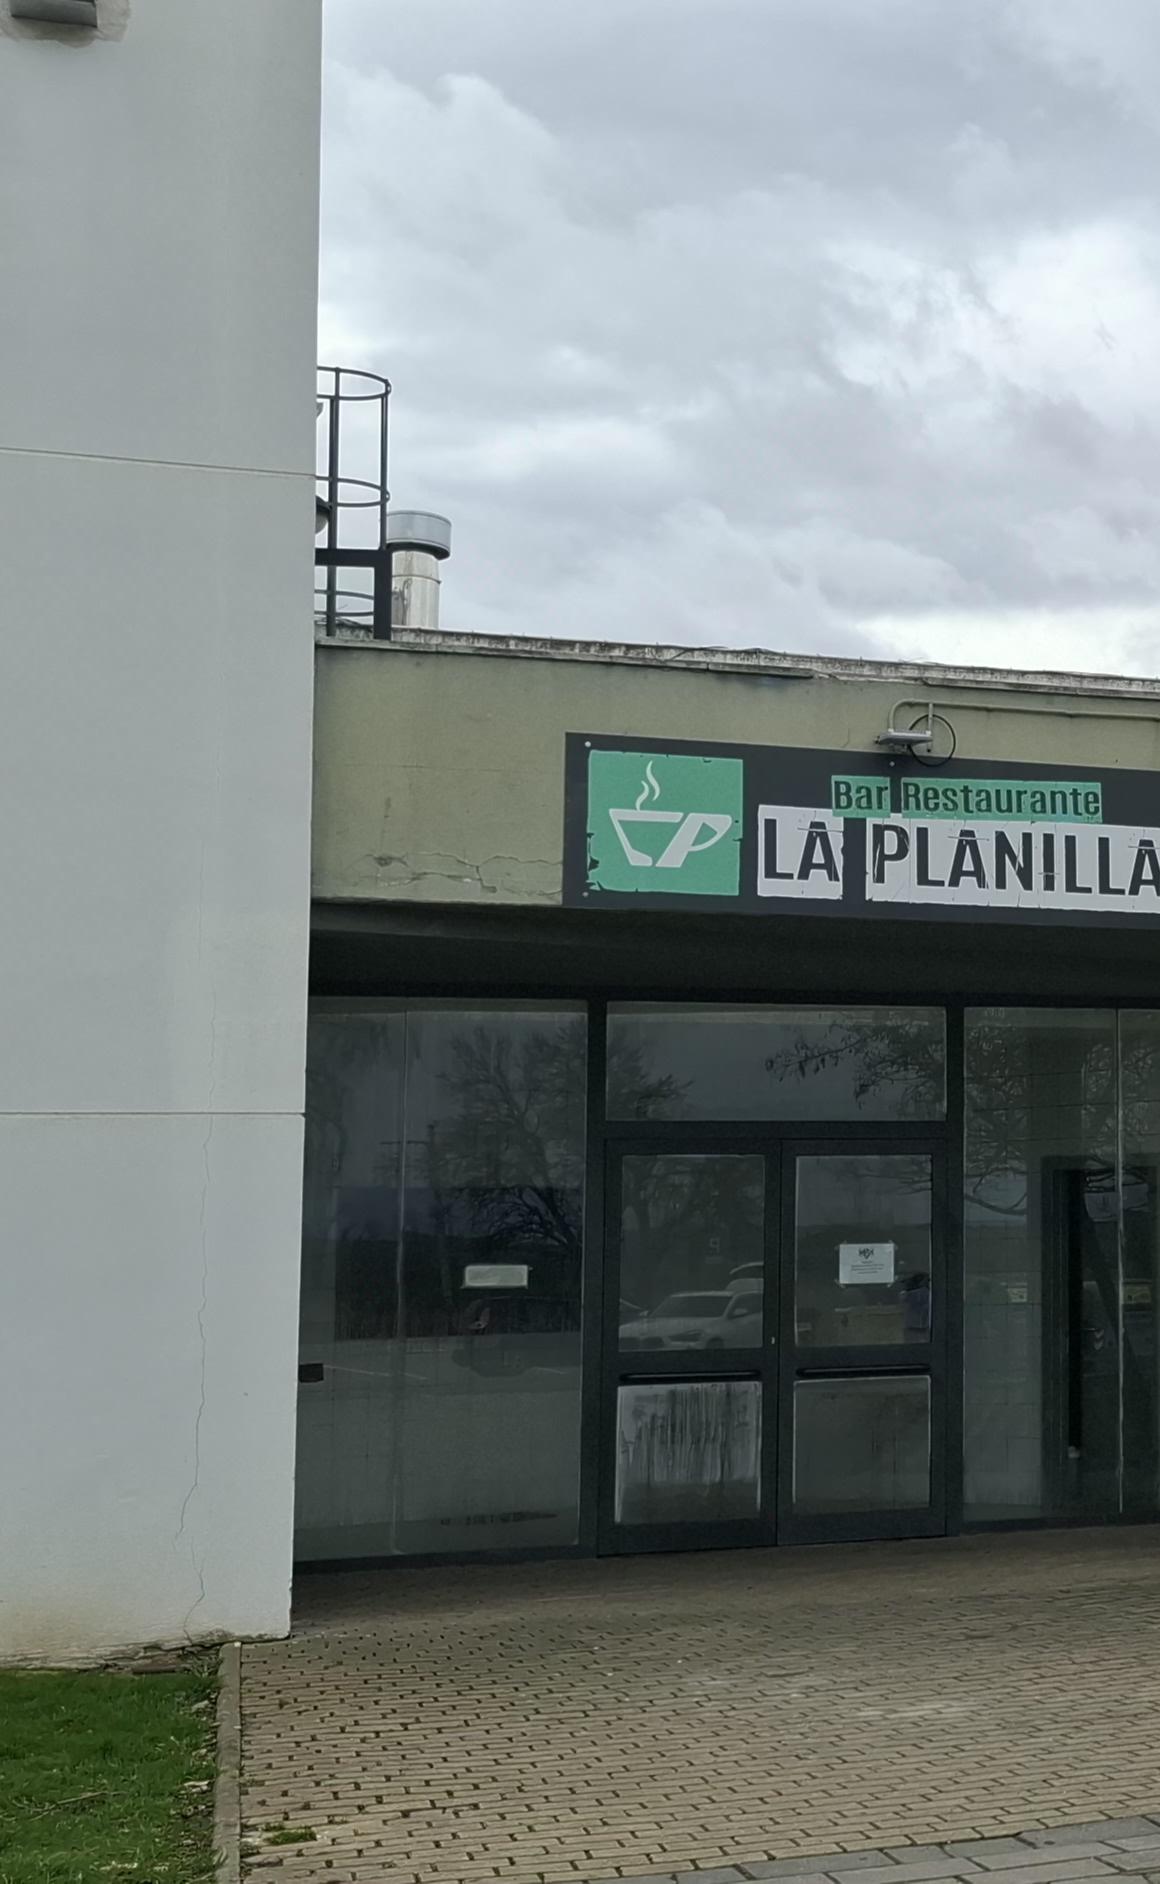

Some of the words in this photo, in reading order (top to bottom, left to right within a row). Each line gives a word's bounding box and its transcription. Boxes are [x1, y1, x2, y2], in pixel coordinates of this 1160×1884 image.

[833, 779, 889, 811] Bar
[902, 781, 1101, 817] Restaurante
[763, 818, 841, 882] LA
